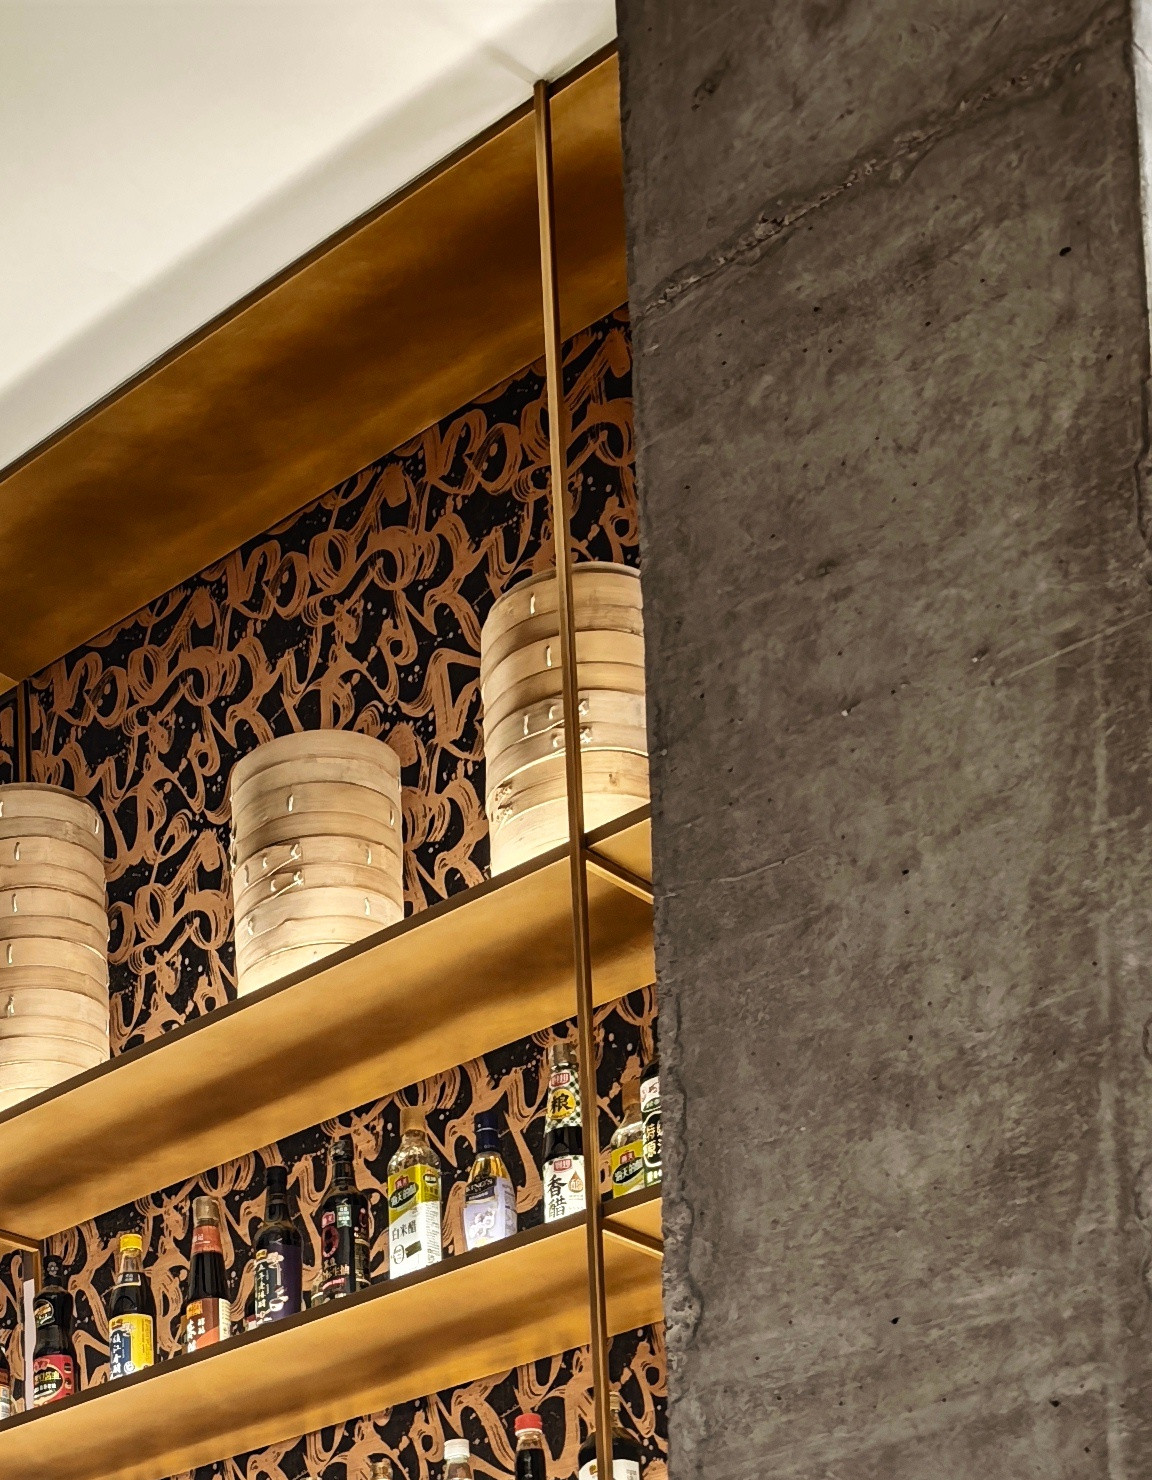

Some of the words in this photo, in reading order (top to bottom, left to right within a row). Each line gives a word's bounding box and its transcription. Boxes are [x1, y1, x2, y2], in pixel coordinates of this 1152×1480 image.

[547, 1174, 567, 1219] 香醋
[392, 1220, 417, 1241] 白米醋
